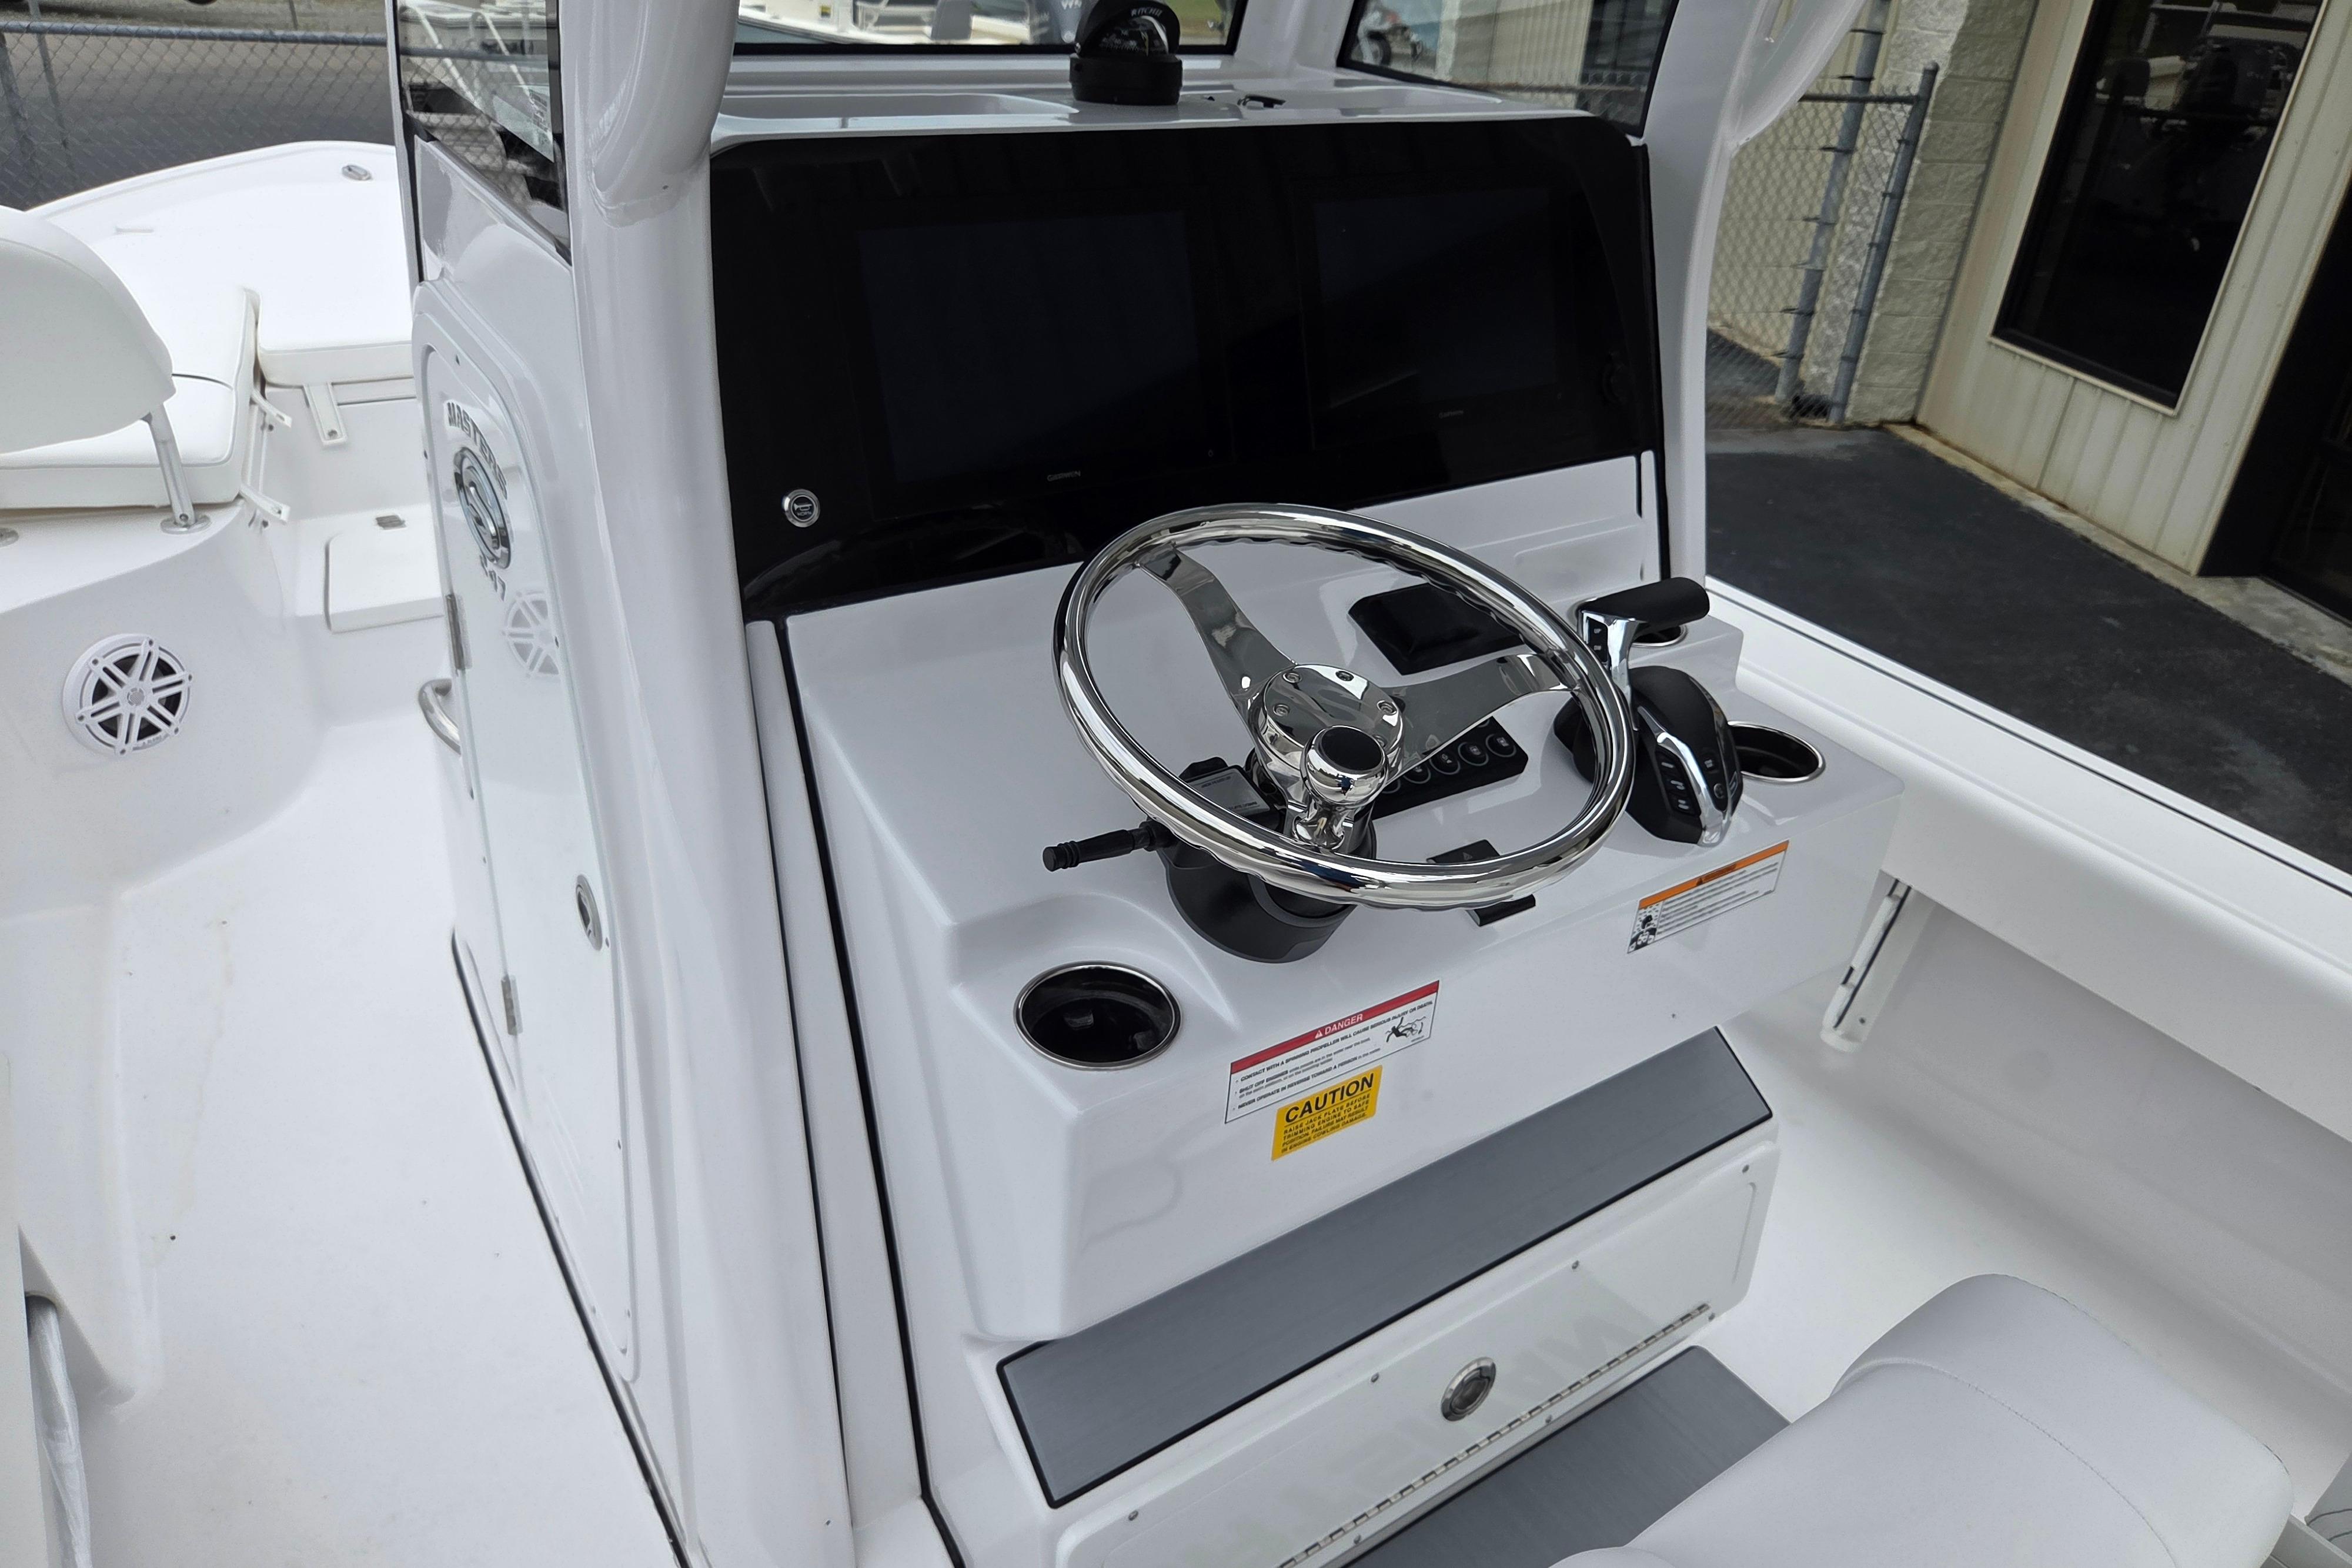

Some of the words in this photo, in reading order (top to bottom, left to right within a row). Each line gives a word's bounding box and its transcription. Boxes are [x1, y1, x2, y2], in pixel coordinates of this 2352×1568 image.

[1324, 1012, 1364, 1035] DANGER
[1265, 1061, 1279, 1072] WITH
[1282, 1122, 1315, 1141] TRIMMING
[1317, 1111, 1341, 1126] ENGINE
[1342, 1106, 1352, 1115] TO
[1353, 1098, 1369, 1110] SAFE
[1283, 1121, 1304, 1135] RAISE
[1305, 1114, 1322, 1126] JACK
[1323, 1104, 1344, 1118] PLATE
[1345, 1092, 1370, 1108] BEFORE
[1284, 1072, 1374, 1125] CAUTION
